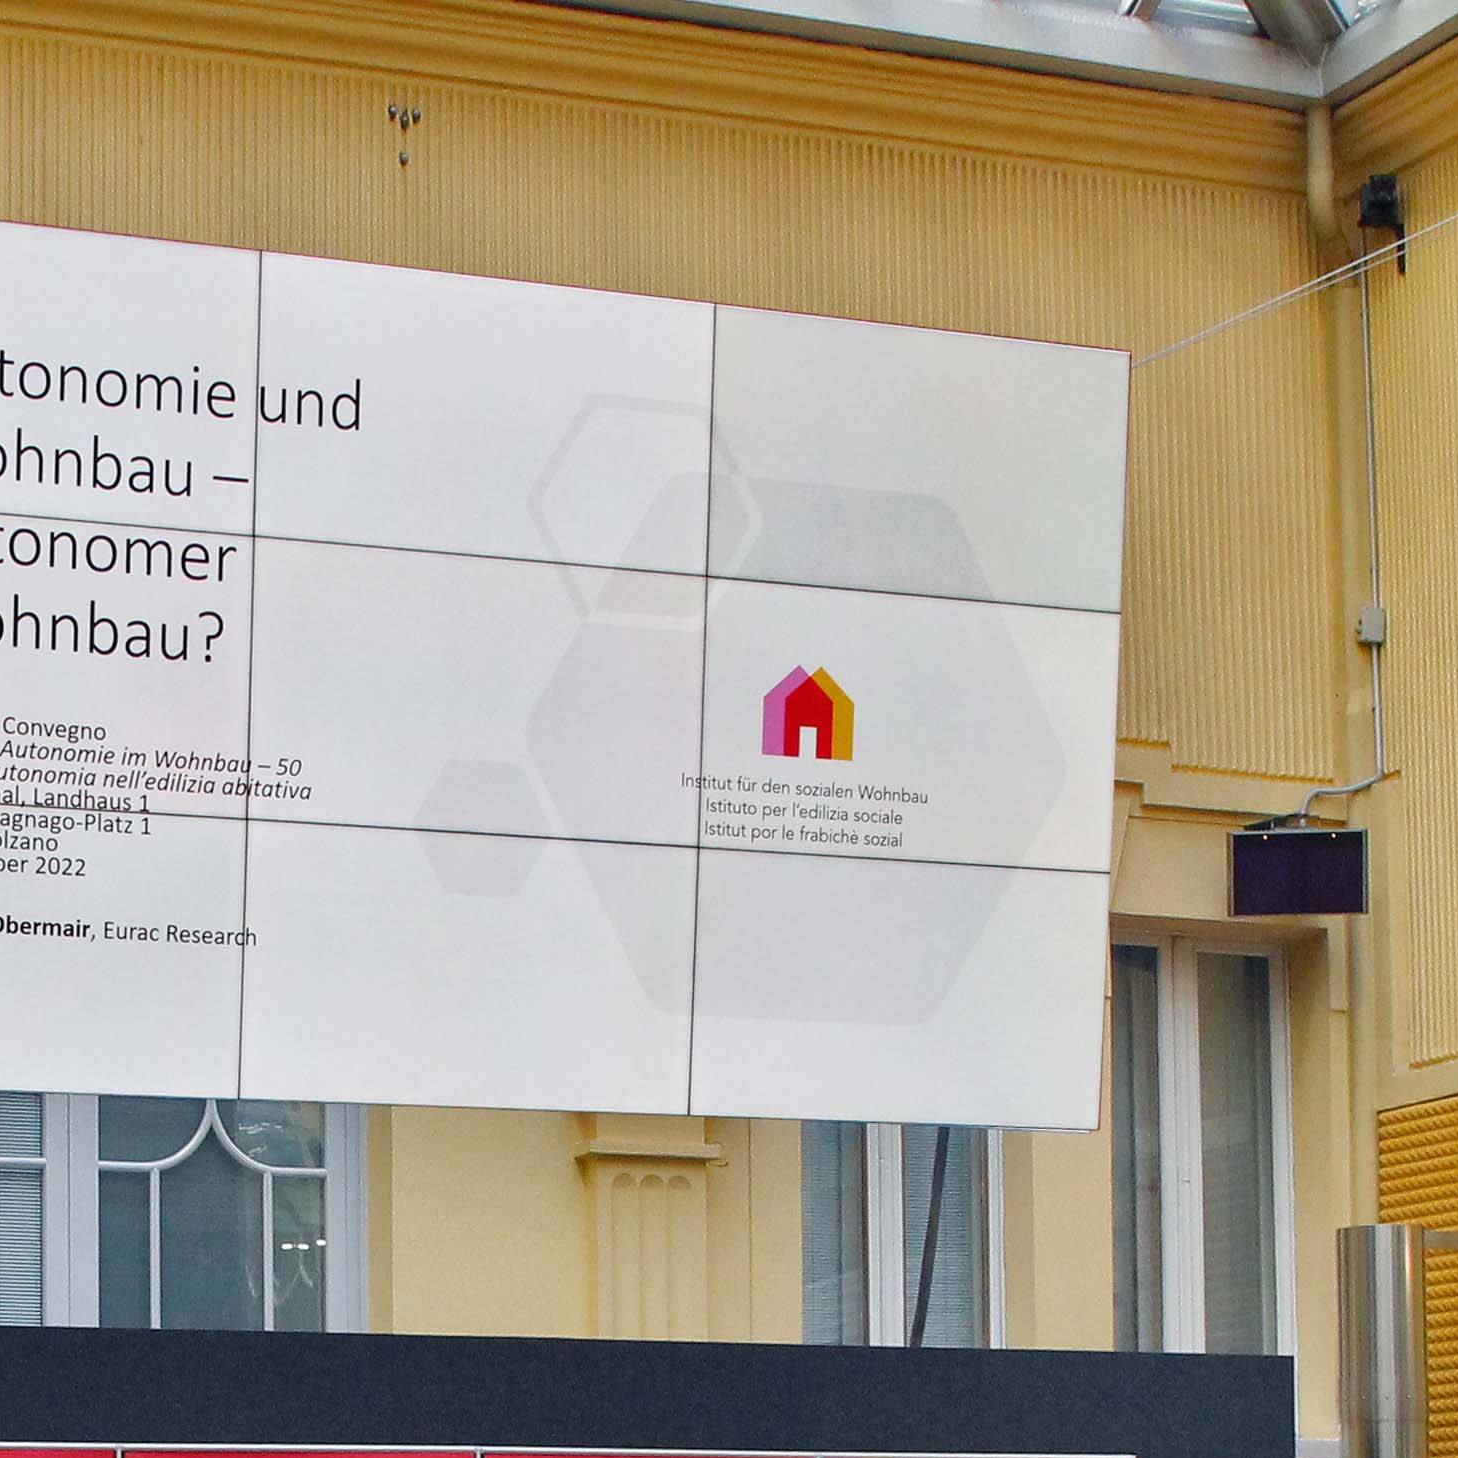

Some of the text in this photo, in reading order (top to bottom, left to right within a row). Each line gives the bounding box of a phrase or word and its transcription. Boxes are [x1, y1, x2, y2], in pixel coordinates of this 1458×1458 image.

[259, 378, 361, 431] und
[3, 716, 107, 744] Convegno
[0, 740, 116, 765] Autonomie
[121, 747, 147, 766] im
[155, 750, 251, 774] Wohnbau
[276, 758, 302, 777] 50
[103, 770, 215, 794] nell'edilizia
[222, 777, 312, 801] abitativa
[681, 772, 929, 805] Institut für den sozialen Wohnbau
[34, 787, 132, 812] Landhaus
[139, 794, 150, 814] 1
[706, 797, 903, 825] Istituto per l'edilizia sociale
[141, 817, 151, 835] 1
[704, 820, 746, 838] Istitut
[750, 826, 778, 843] por
[781, 824, 795, 840] le
[863, 831, 903, 848] sozial
[35, 857, 86, 877] 2022
[104, 921, 160, 942] Eurac
[166, 924, 257, 947] Research
